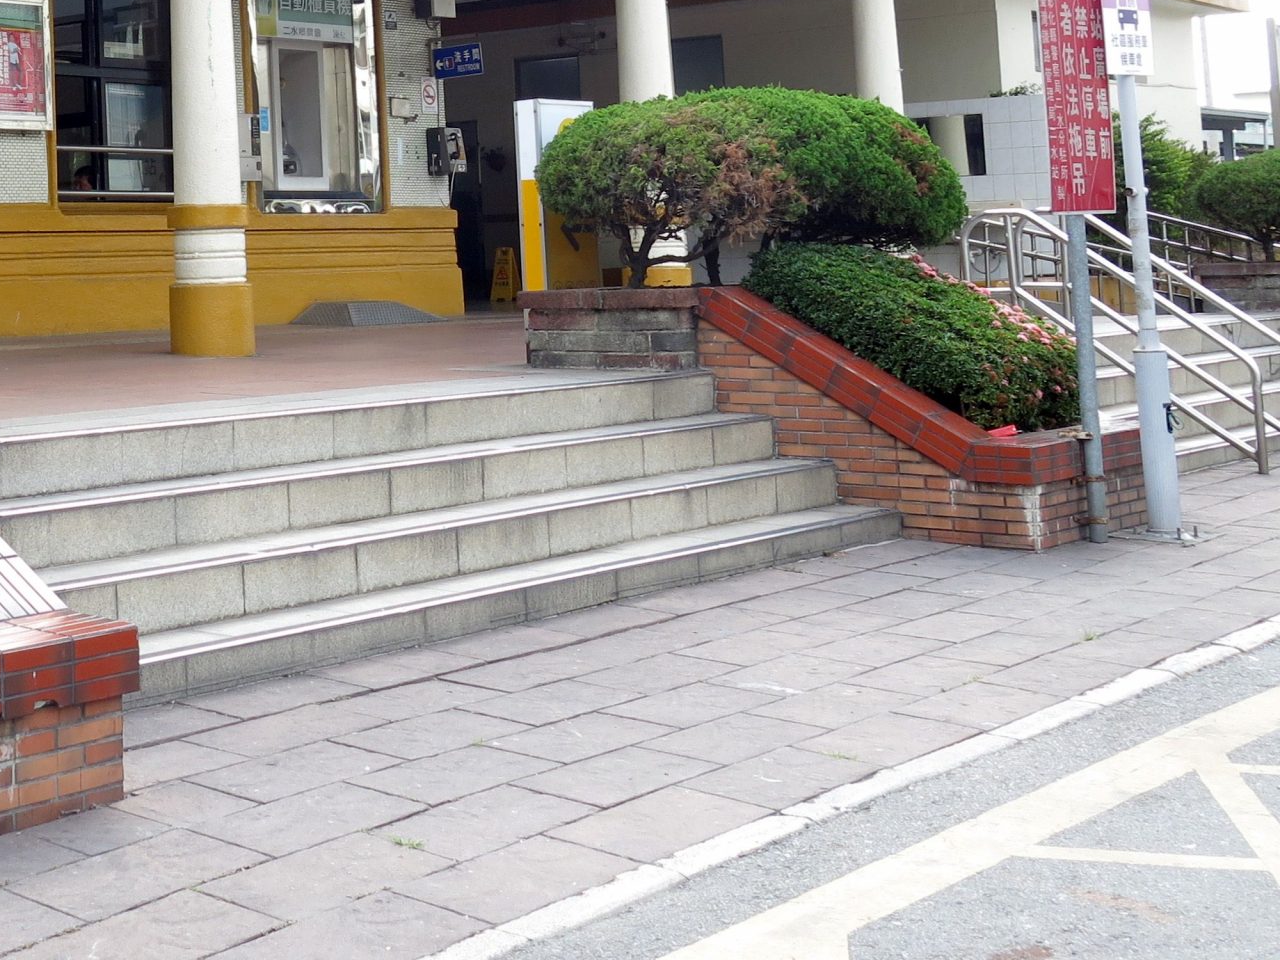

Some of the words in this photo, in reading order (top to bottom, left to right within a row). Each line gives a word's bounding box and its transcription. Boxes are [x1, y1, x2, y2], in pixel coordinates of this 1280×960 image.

[453, 48, 481, 63] 洗手間
[1074, 5, 1098, 161] 禁止停車
